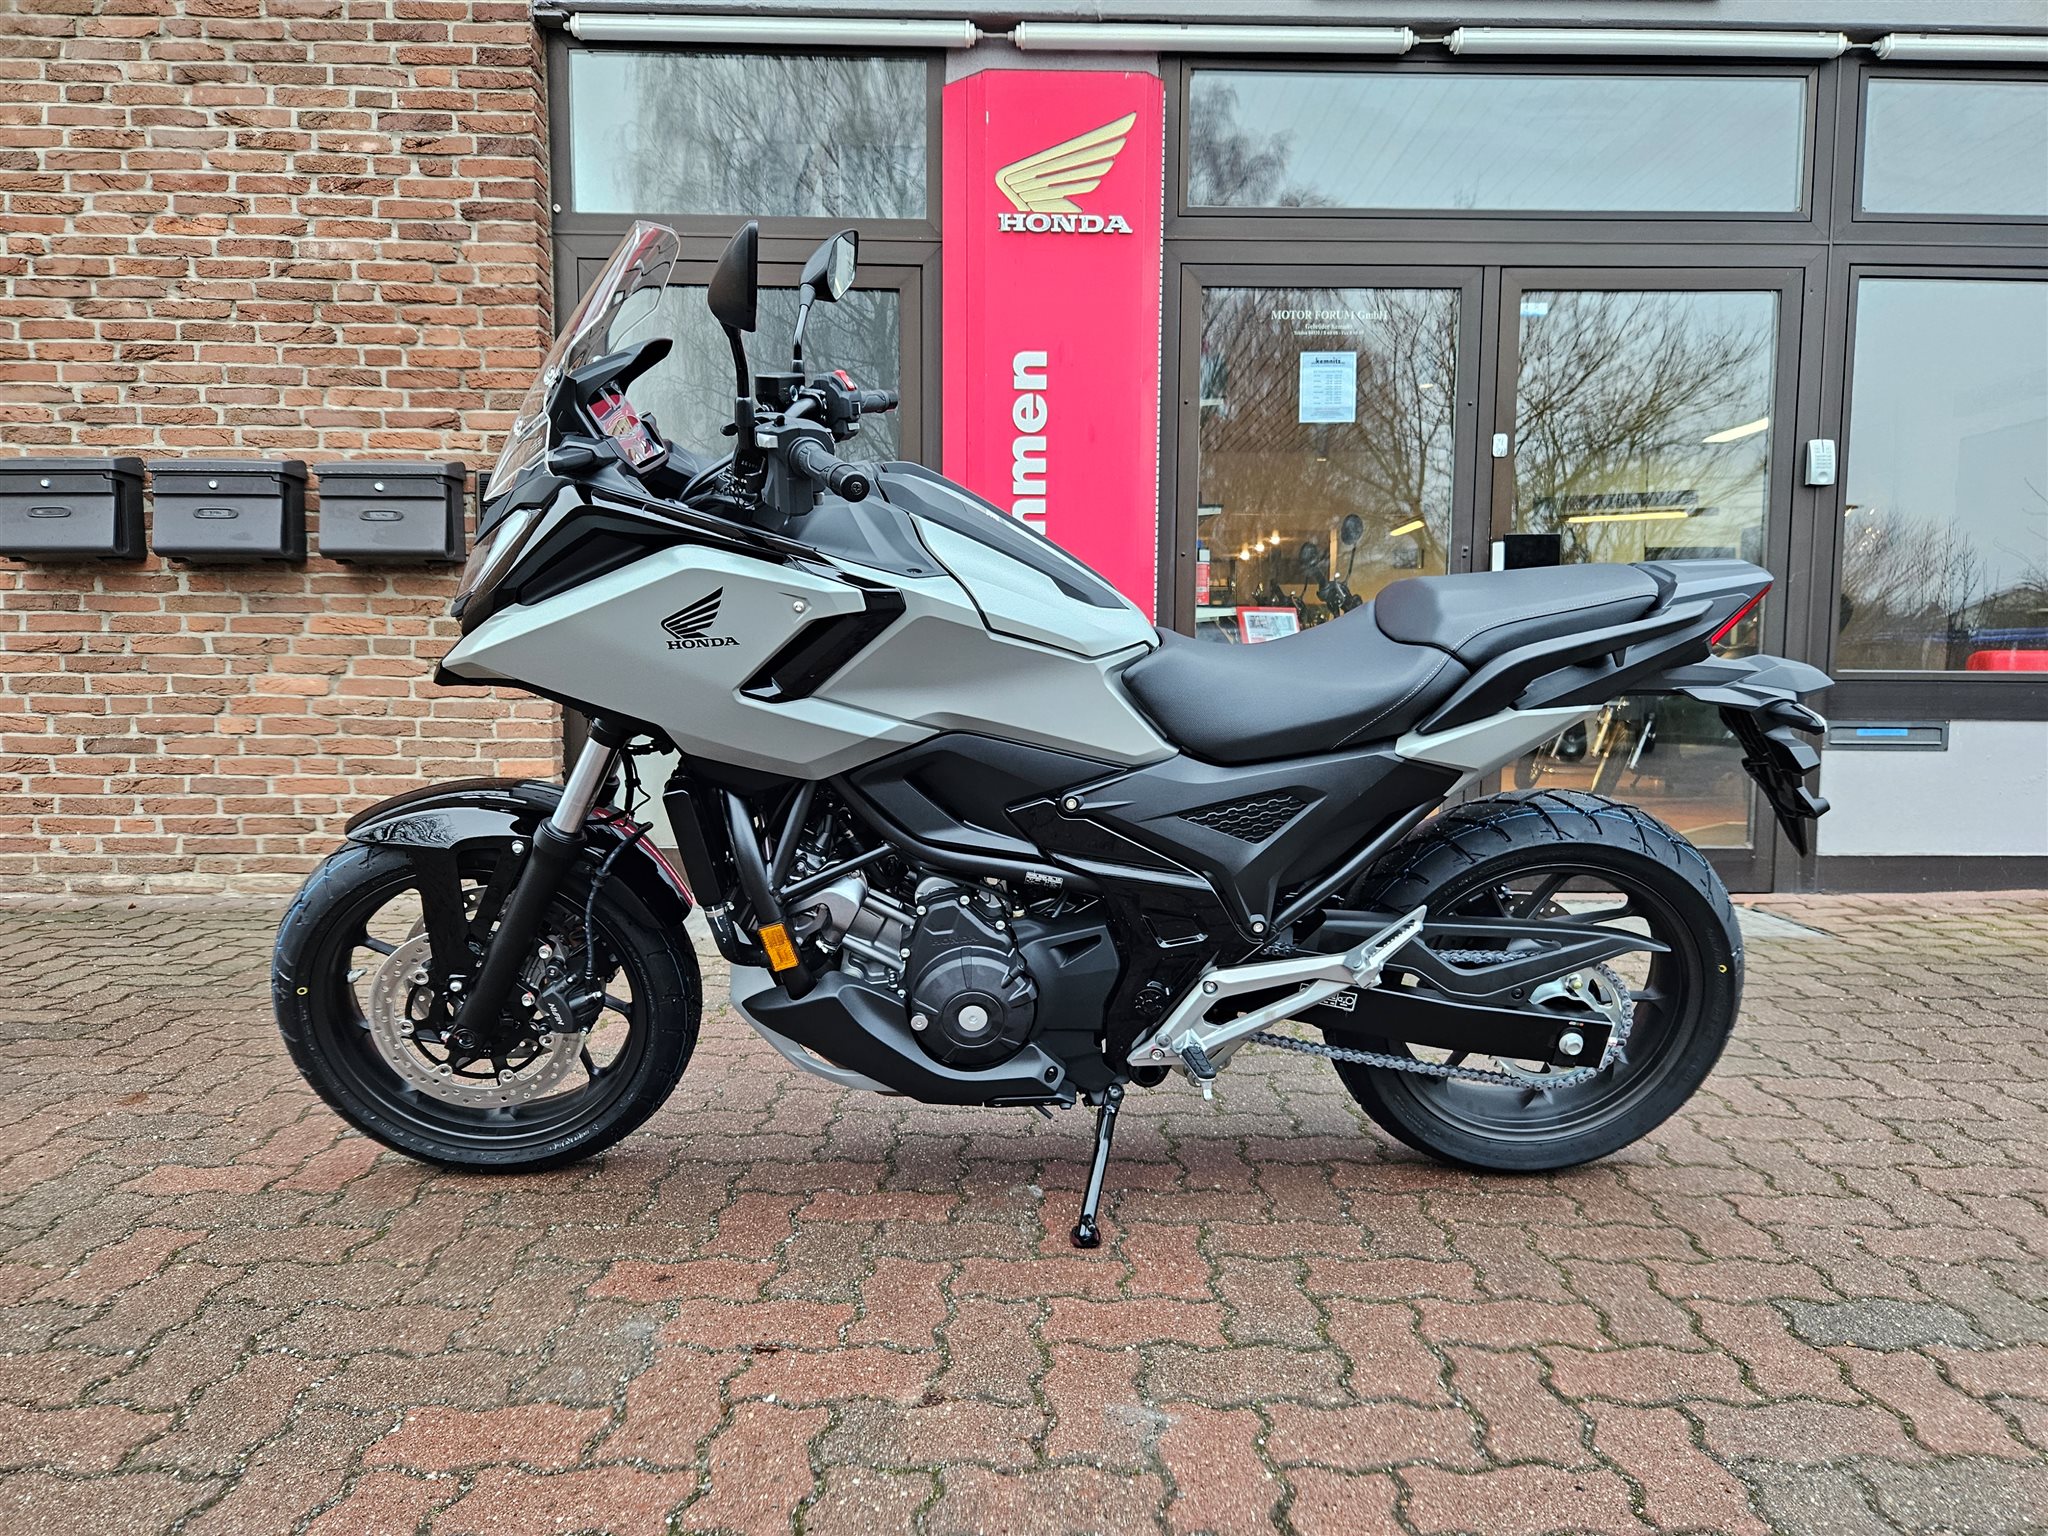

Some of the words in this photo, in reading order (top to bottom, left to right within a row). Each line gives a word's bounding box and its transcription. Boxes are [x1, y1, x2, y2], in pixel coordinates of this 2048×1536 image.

[997, 213, 1133, 234] HONDA
[1271, 310, 1312, 320] MOTOR
[1315, 310, 1355, 320] FORUM
[1359, 310, 1388, 320] GmbH
[666, 636, 740, 650] HONDA
